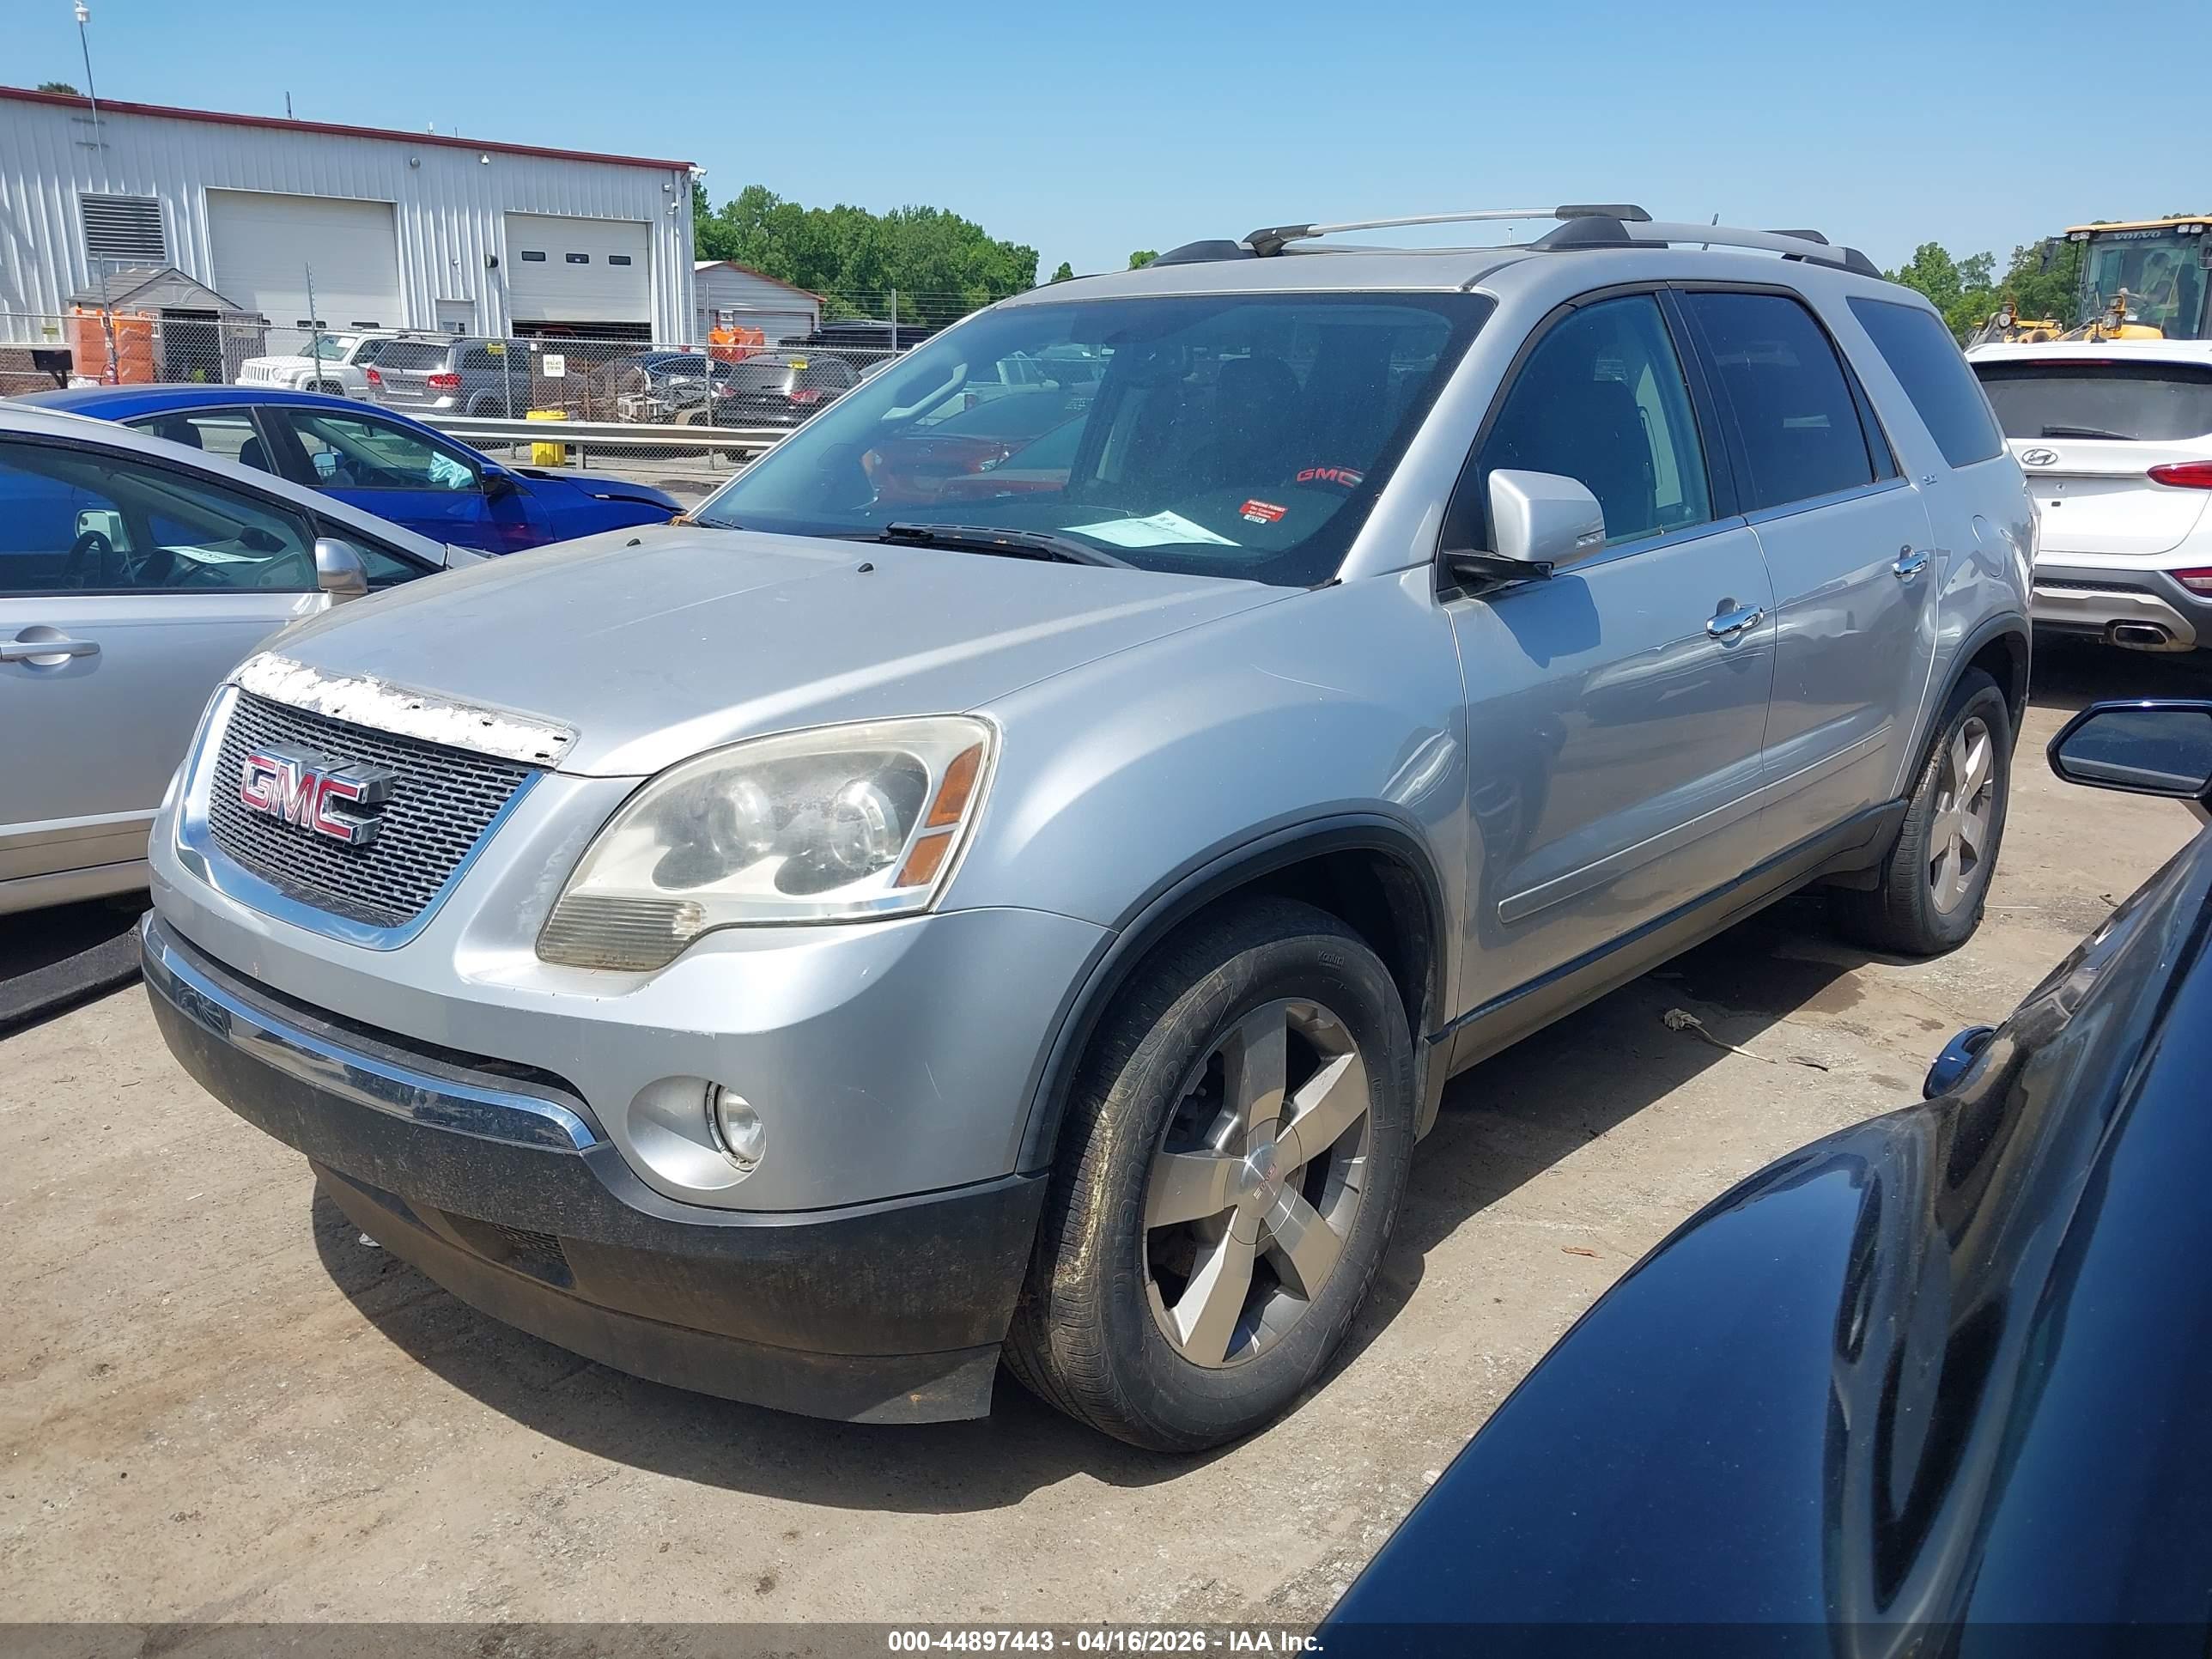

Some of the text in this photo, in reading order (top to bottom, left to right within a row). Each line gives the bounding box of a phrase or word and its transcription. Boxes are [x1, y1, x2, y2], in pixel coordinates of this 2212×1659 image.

[2113, 230, 2161, 240] VOLVO
[1297, 466, 1365, 489] GMC
[241, 750, 369, 845] GMC
